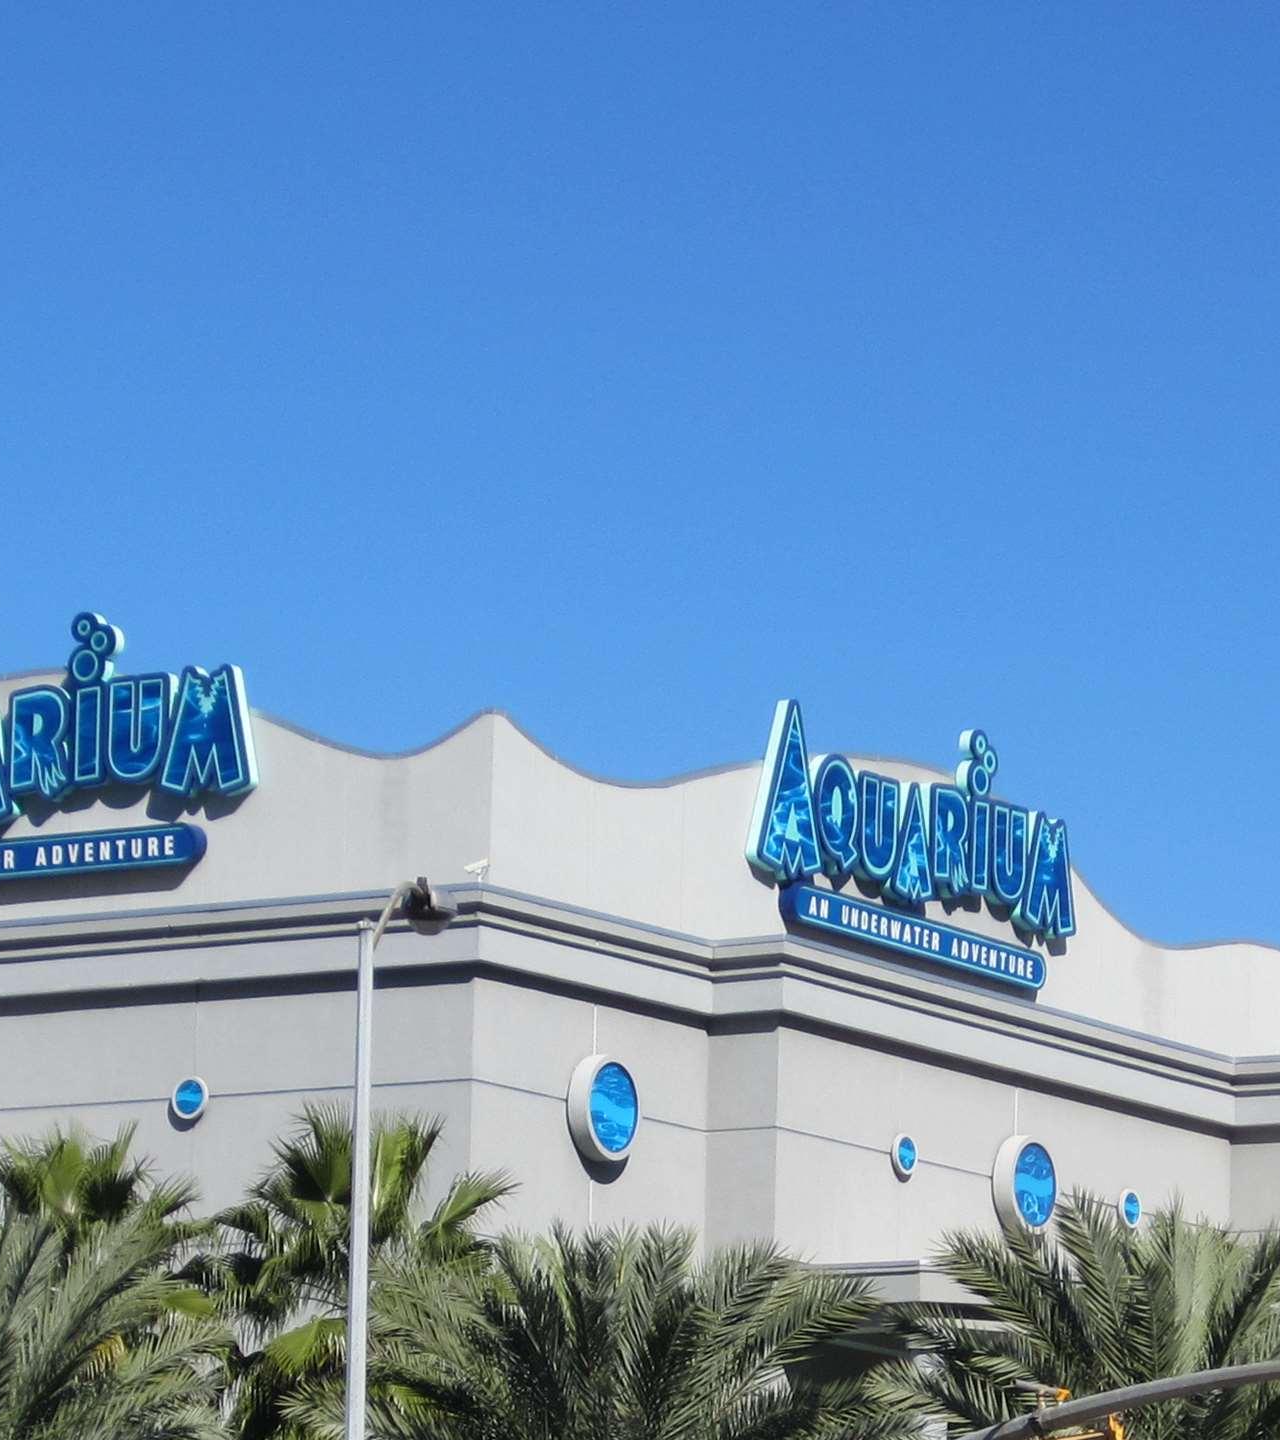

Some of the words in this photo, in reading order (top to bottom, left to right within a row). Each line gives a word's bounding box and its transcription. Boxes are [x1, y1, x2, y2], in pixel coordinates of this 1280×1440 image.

[35, 835, 177, 867] ADVENTURE
[745, 699, 1076, 937] AQUARIUM
[808, 895, 829, 919] AN
[841, 906, 940, 952] UNDERWATER
[951, 937, 1034, 980] ADVENTURE
